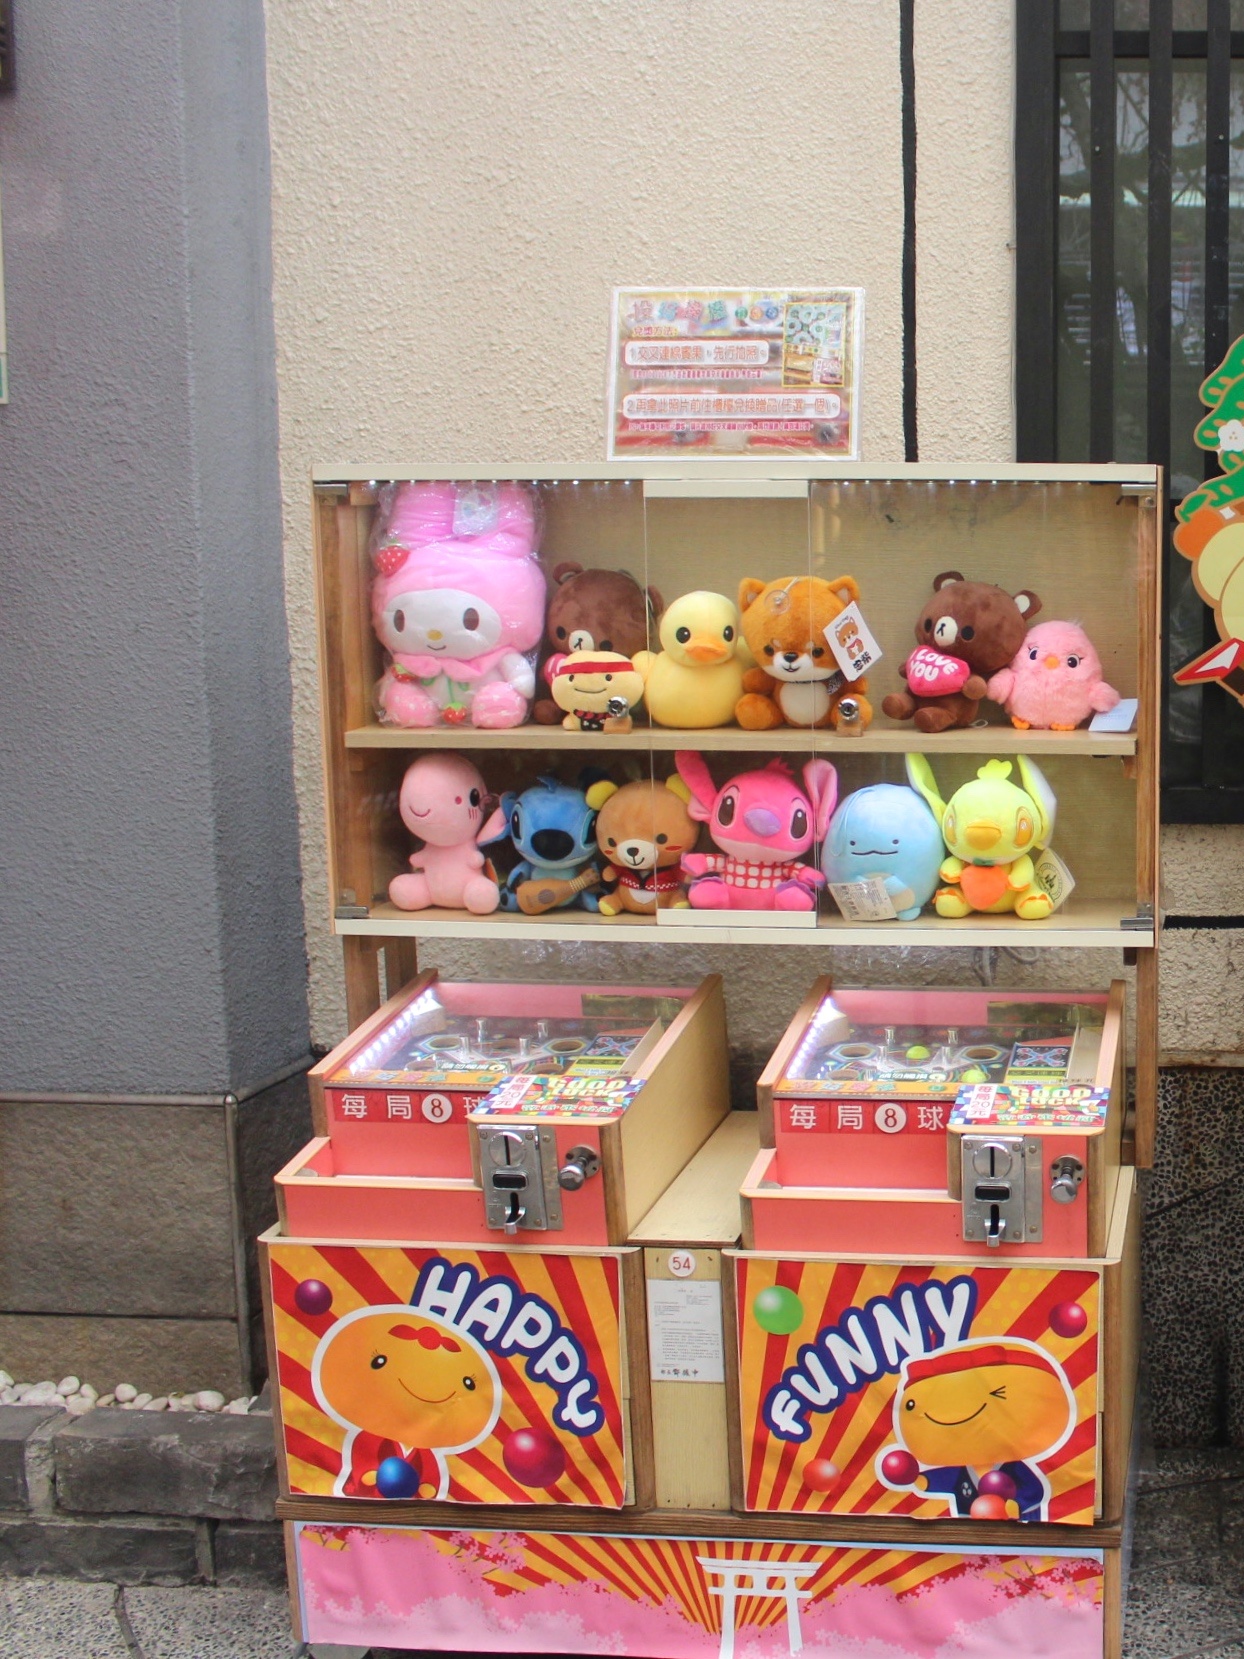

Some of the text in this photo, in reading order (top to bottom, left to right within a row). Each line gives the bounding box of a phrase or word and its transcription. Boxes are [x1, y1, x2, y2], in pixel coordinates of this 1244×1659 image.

[916, 648, 959, 675] LOVE
[910, 660, 939, 682] YOU
[548, 1077, 627, 1090] GOOD
[550, 1088, 610, 1098] LUCK
[1010, 1088, 1092, 1099] GOOD
[1018, 1097, 1080, 1107] LUCK
[672, 1256, 691, 1270] 54
[418, 1264, 598, 1428] HAPPY
[771, 1281, 971, 1435] FUNNY
